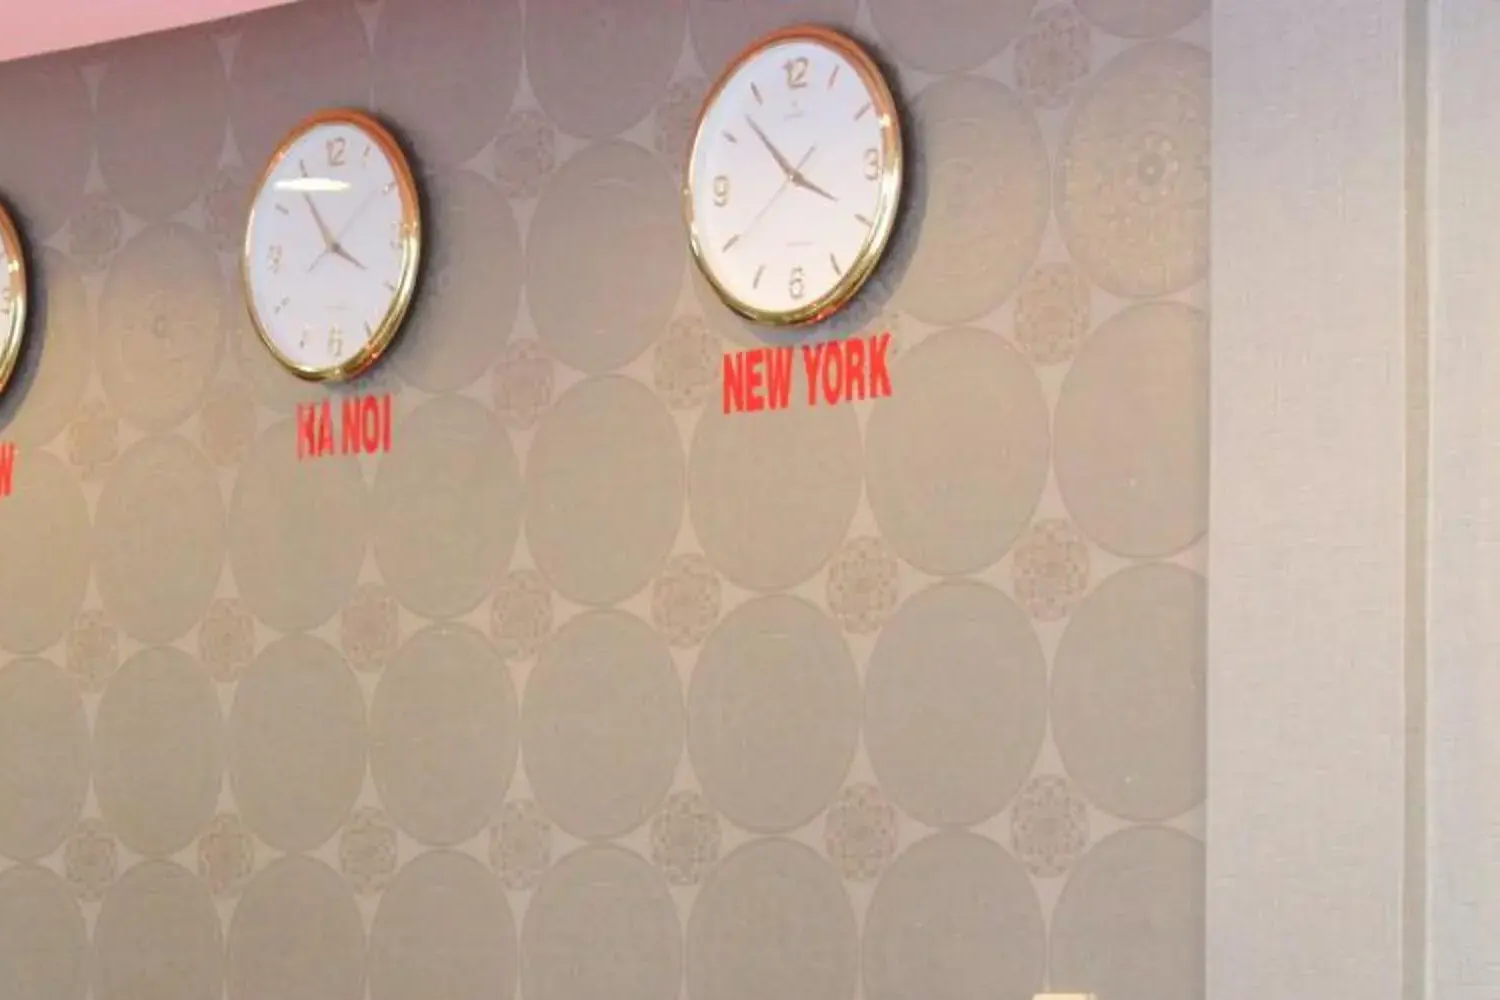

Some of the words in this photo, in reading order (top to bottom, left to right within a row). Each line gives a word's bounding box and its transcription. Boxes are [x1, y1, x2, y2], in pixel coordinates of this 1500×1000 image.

[780, 57, 809, 90] 12
[325, 136, 348, 168] 12
[863, 148, 881, 182] 3
[712, 176, 730, 208] 9
[788, 266, 806, 301] 6
[723, 347, 794, 415] NEW
[802, 332, 893, 406] YORK
[341, 393, 393, 456] NOI
